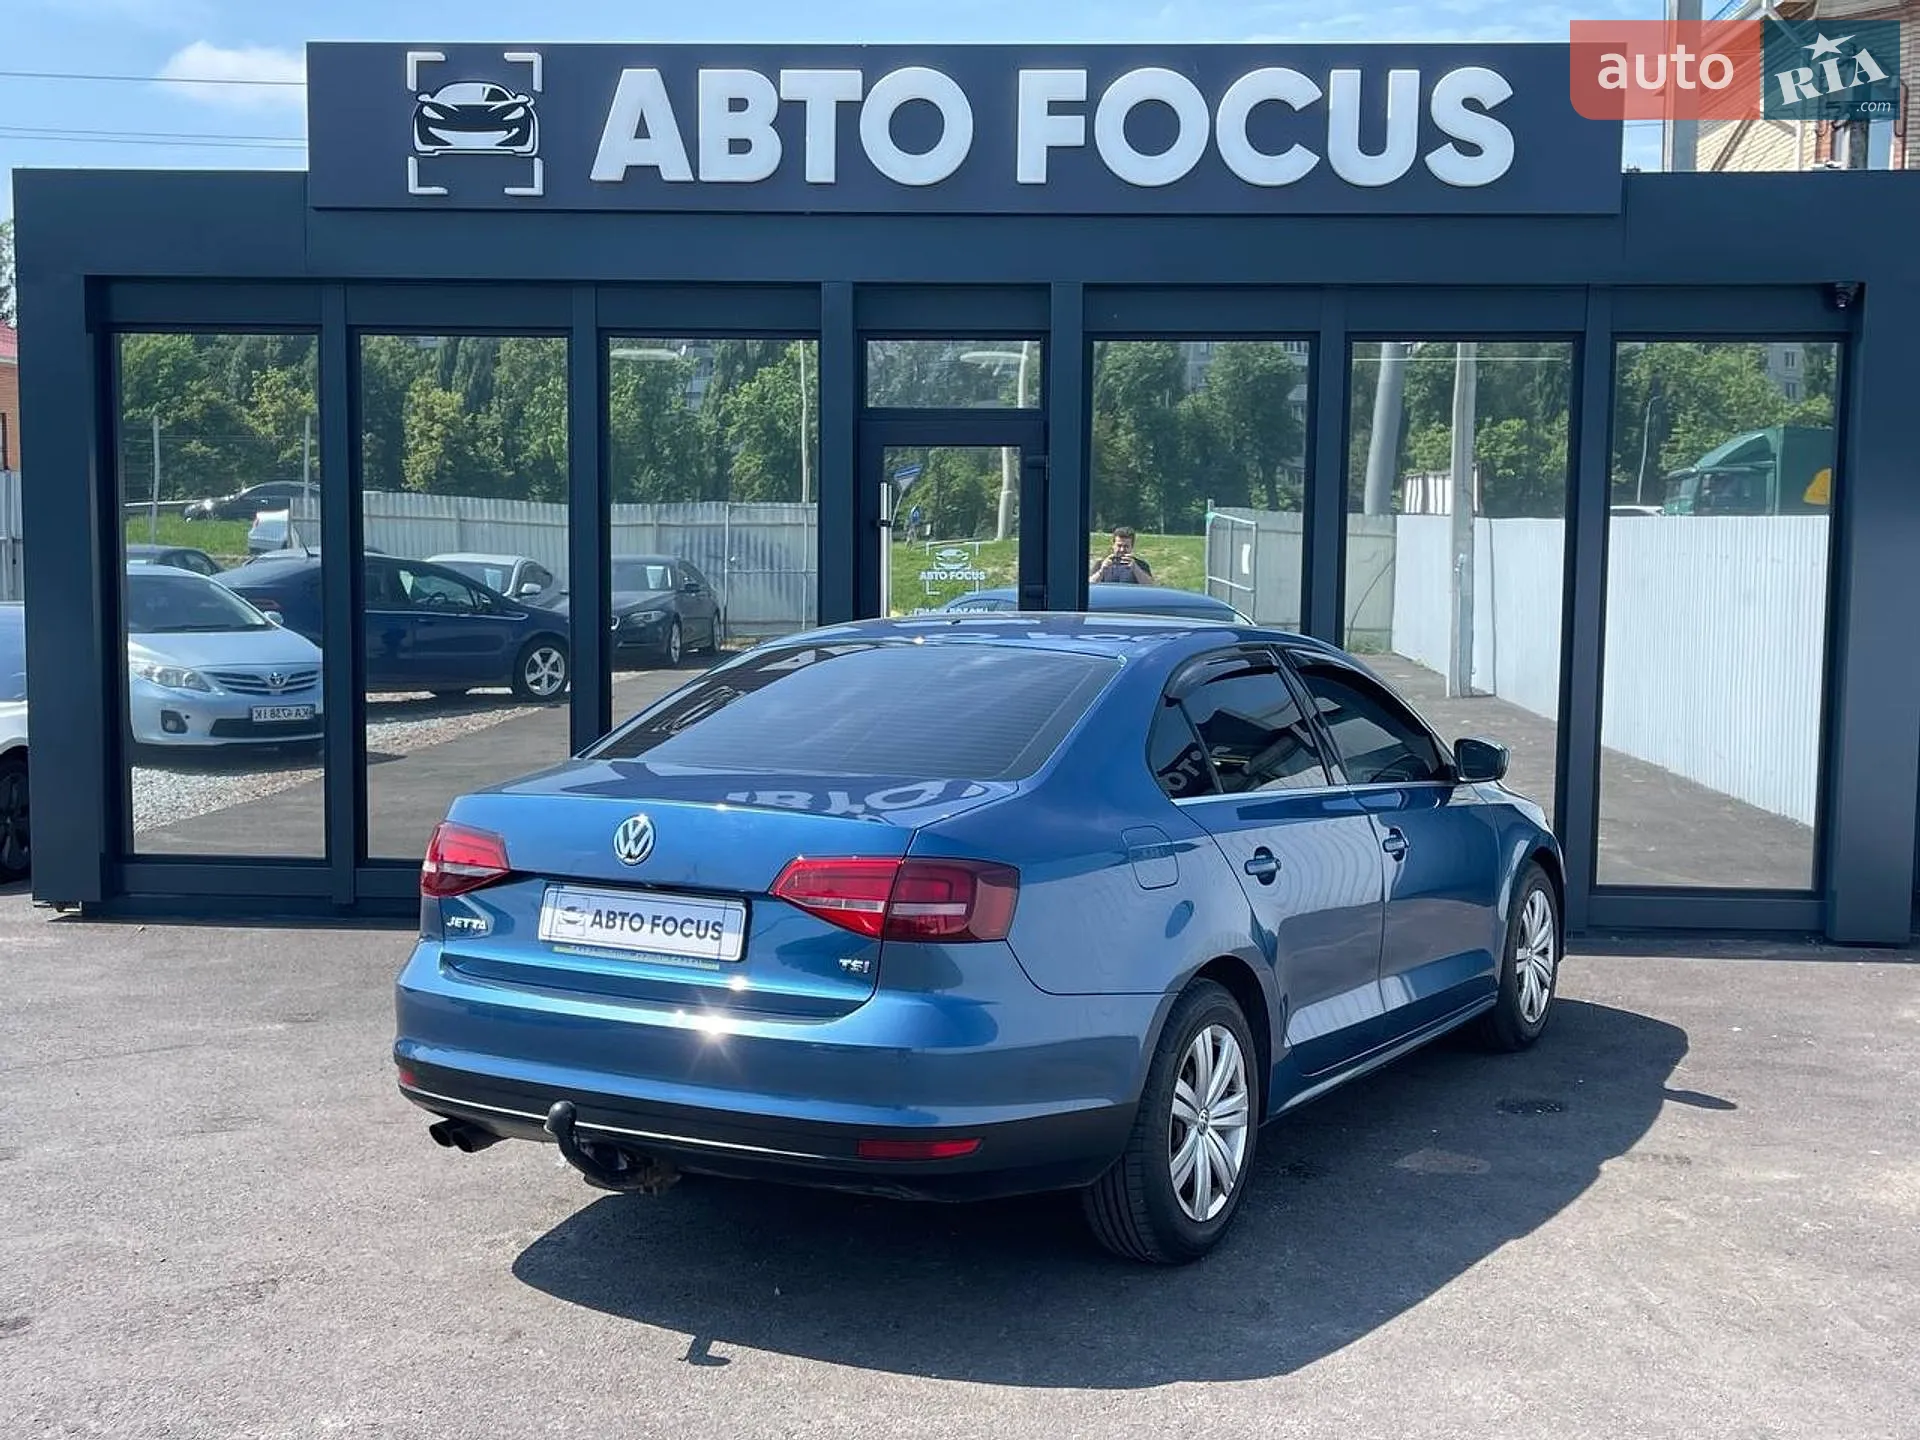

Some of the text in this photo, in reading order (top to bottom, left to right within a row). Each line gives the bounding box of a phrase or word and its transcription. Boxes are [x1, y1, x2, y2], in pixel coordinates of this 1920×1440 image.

[590, 67, 1515, 187] АВТО FOCUS
[950, 571, 986, 580] FOCUS
[446, 916, 487, 930] JETTA
[590, 909, 724, 941] АВТО FOCUS
[839, 958, 870, 973] TSI
